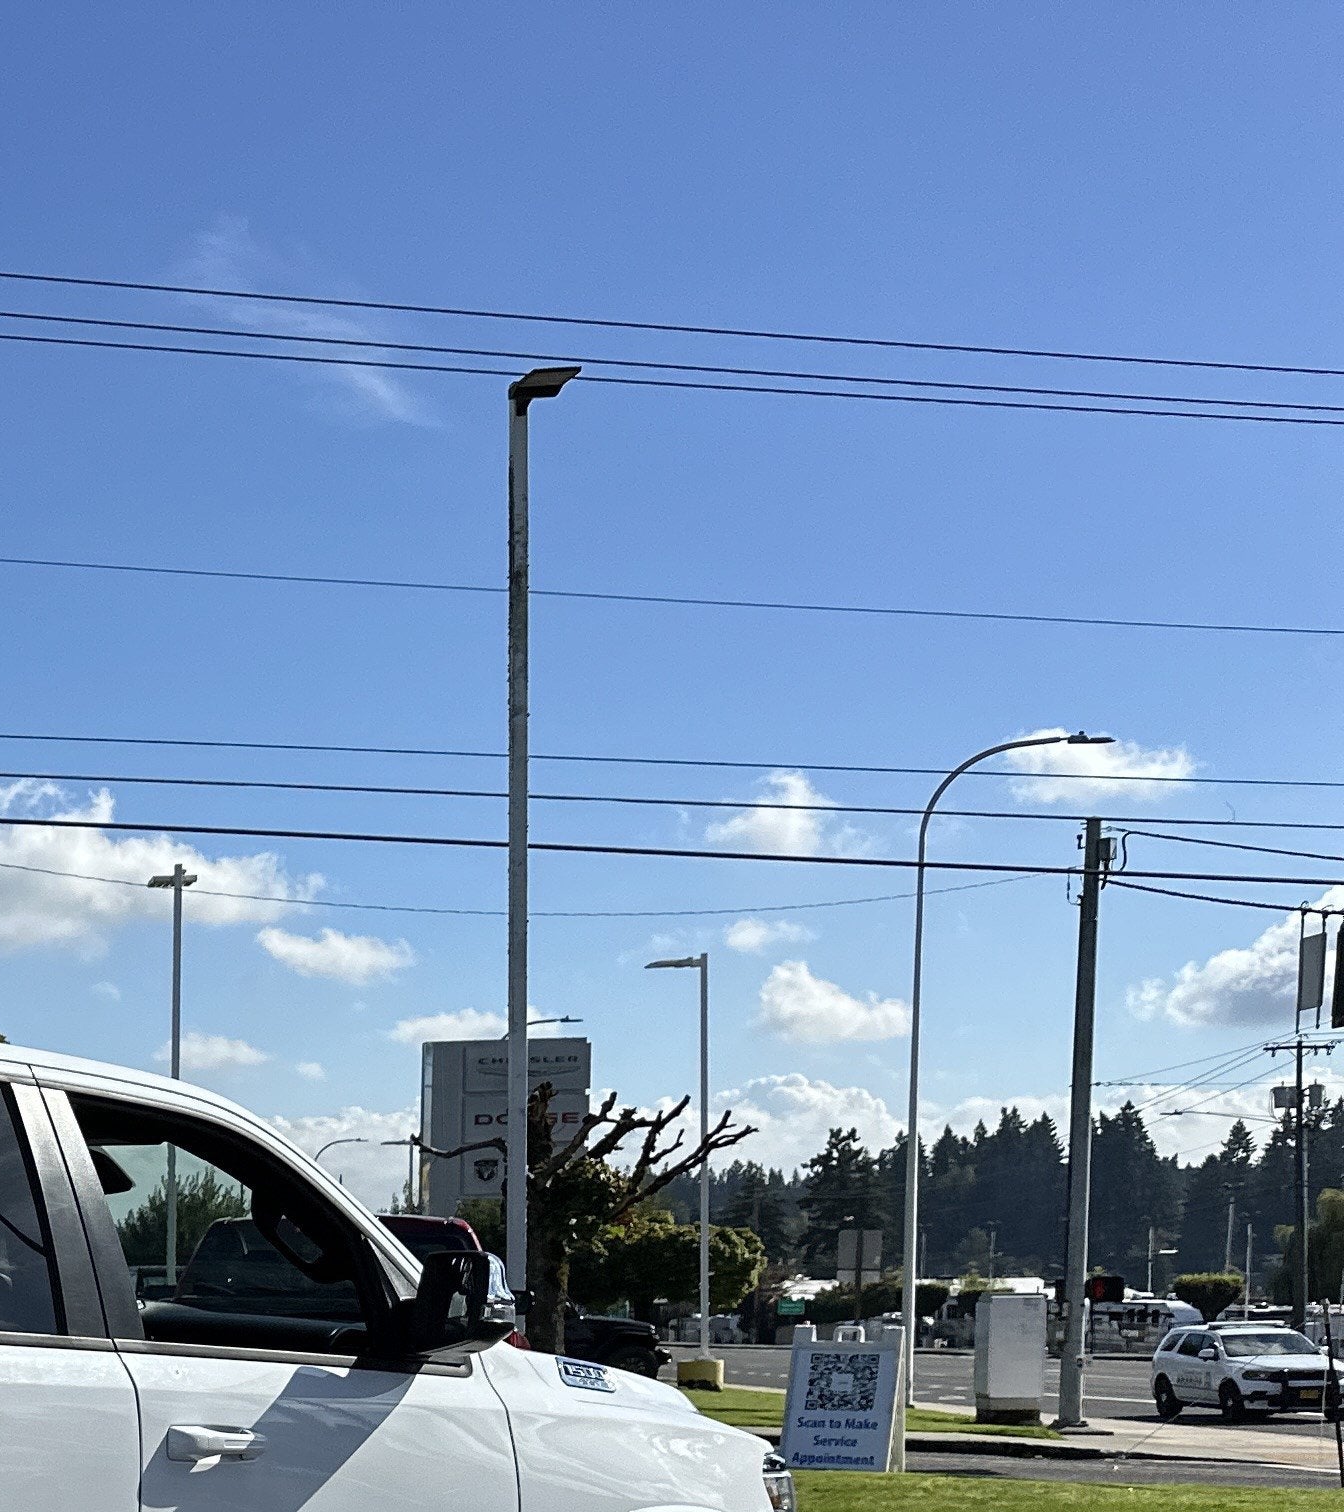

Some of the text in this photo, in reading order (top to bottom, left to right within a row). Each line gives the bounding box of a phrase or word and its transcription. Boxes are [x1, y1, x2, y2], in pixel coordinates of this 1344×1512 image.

[474, 1112, 580, 1125] DOGE
[797, 1417, 879, 1430] Scan to Make
[813, 1435, 858, 1447] Service
[792, 1452, 875, 1466] Appointment
